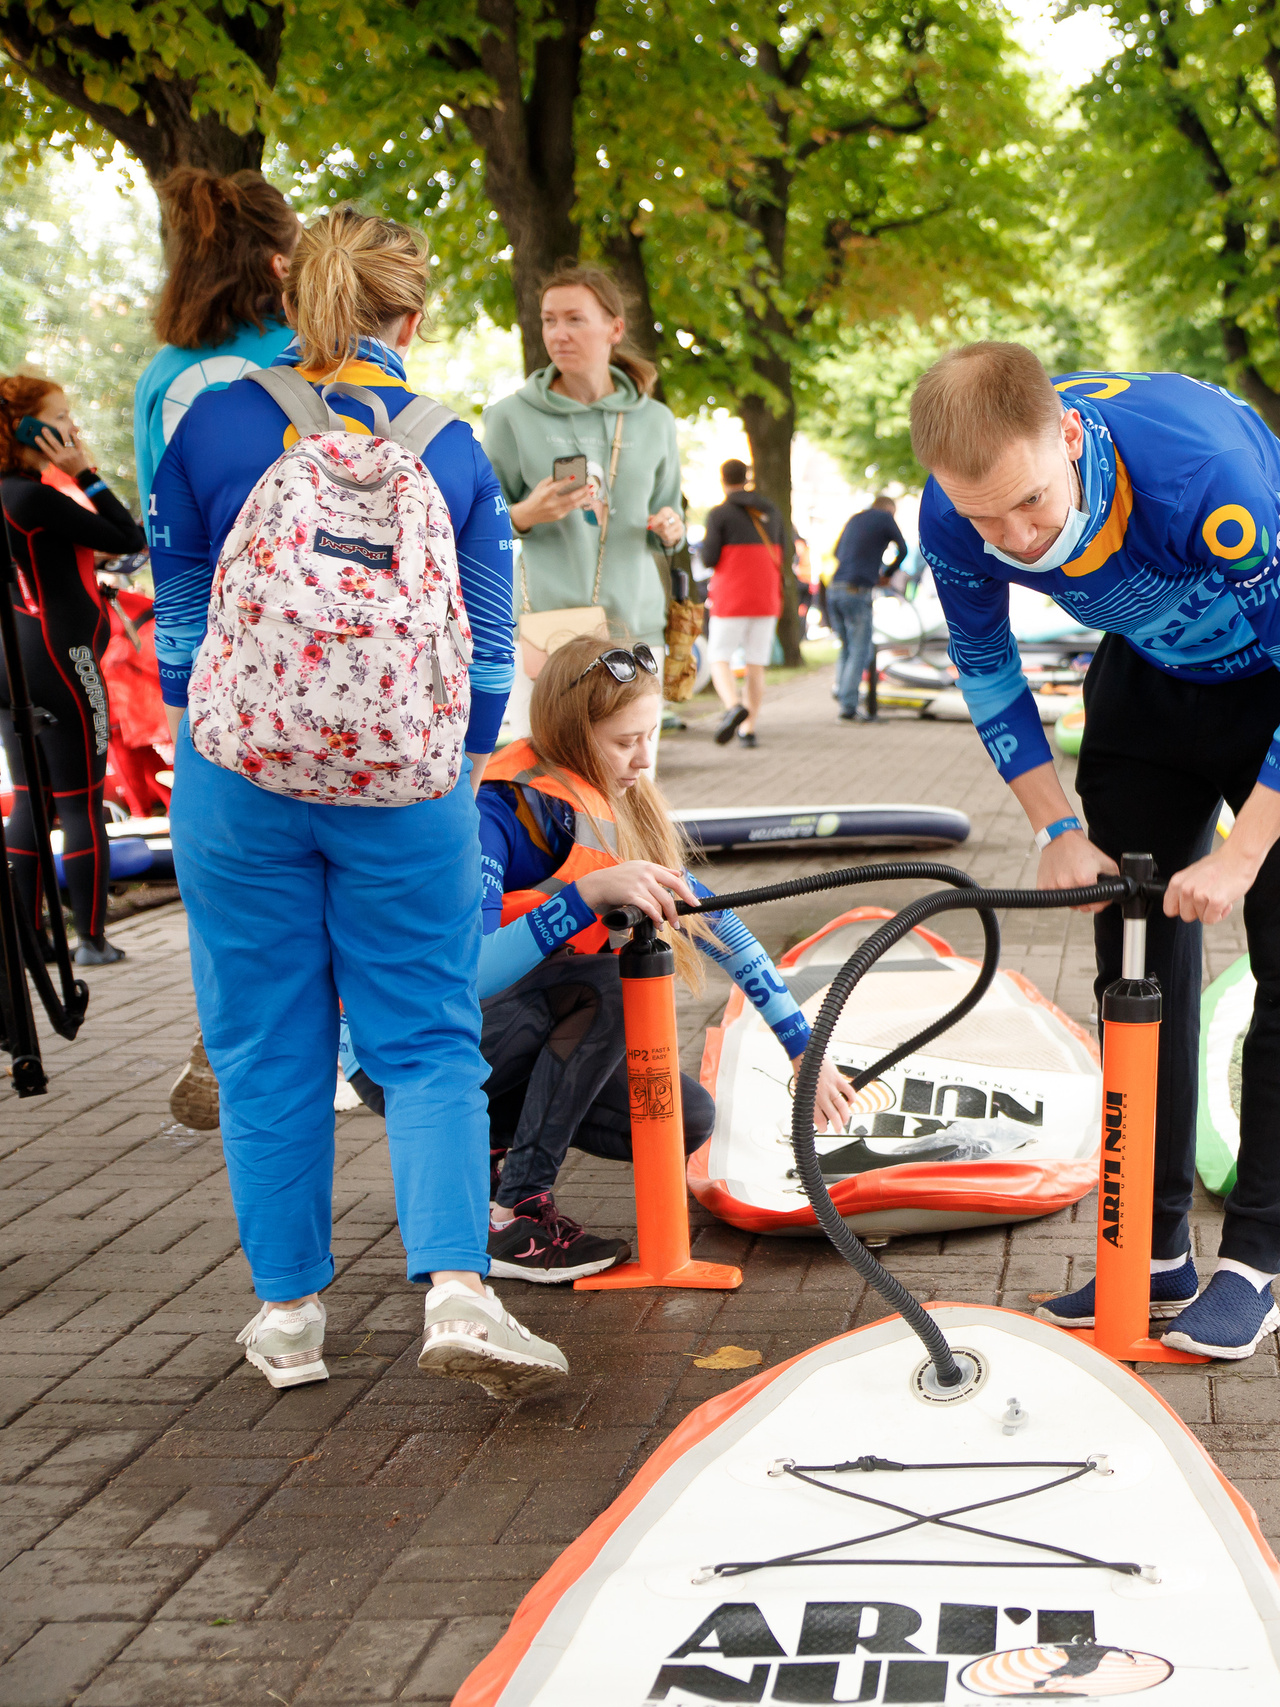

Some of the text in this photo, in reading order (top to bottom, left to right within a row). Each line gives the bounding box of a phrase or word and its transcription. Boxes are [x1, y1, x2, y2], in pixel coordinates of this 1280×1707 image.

[319, 536, 388, 561] JANSPORT
[69, 645, 108, 756] SCORPENA
[832, 1055, 1044, 1099] STAND UP PADLES
[901, 1078, 1044, 1127] NUI
[1104, 1090, 1123, 1153] NUI
[646, 1660, 949, 1705] NUI
